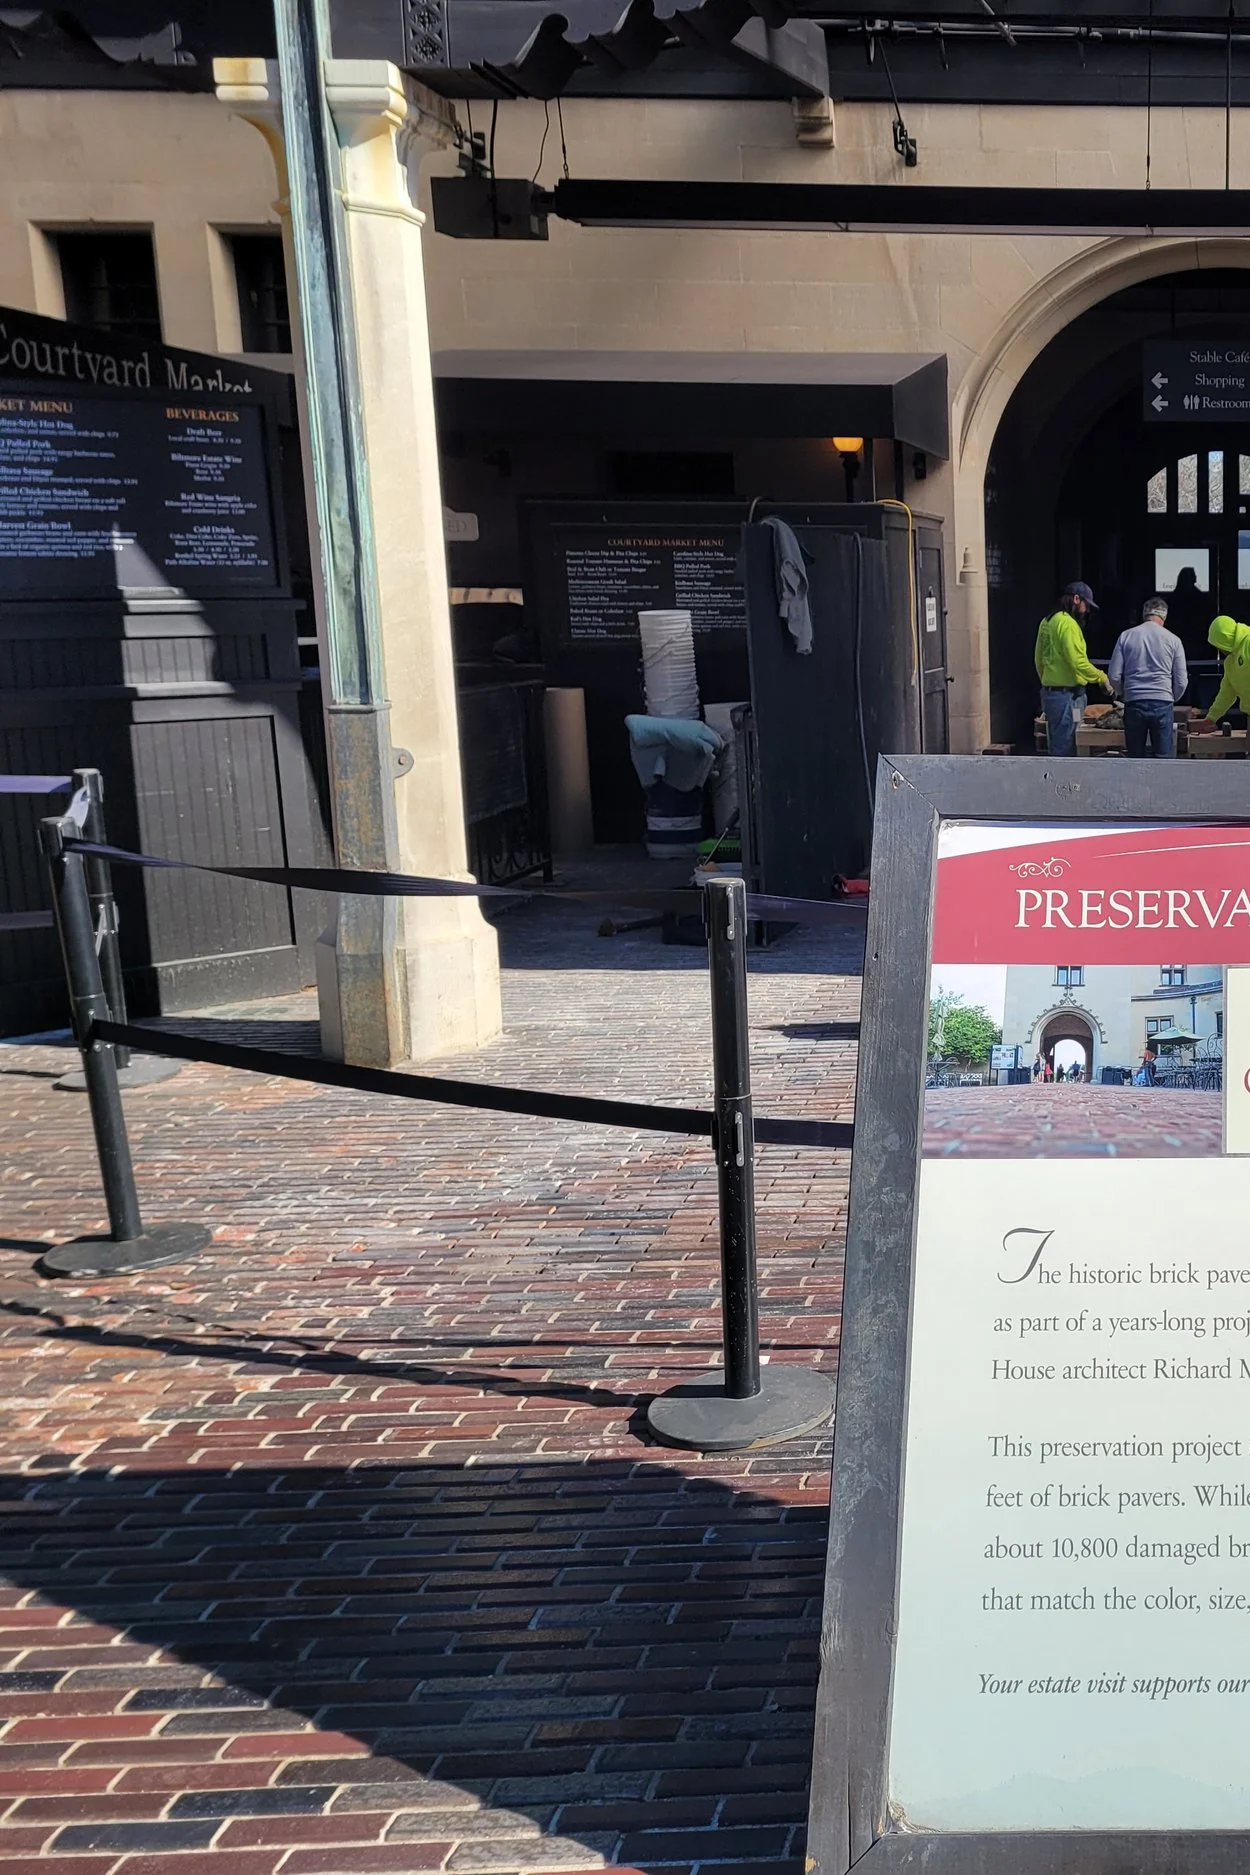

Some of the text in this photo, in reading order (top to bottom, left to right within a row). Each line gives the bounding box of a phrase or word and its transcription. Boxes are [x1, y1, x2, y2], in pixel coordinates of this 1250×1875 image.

[1189, 351, 1250, 364] Stable Café
[1195, 373, 1246, 389] Shopping
[30, 400, 73, 414] MENU
[165, 407, 239, 422] BEVERAGES
[607, 538, 724, 547] COURTYARD MARKET MENU
[997, 1228, 1061, 1284] The
[1069, 1263, 1142, 1284] historic
[1150, 1262, 1200, 1283] brick
[994, 1318, 1012, 1331] as
[1019, 1316, 1059, 1338] part
[1066, 1309, 1088, 1331] of
[1092, 1318, 1102, 1331] a
[1109, 1309, 1206, 1338] years-long
[992, 1360, 1055, 1379] House
[1063, 1358, 1147, 1379] architect
[1153, 1357, 1232, 1379] Richard
[988, 1435, 1031, 1457] This
[1040, 1435, 1163, 1464] preservation
[1171, 1434, 1242, 1463] project
[986, 1484, 1023, 1507] feet
[1030, 1484, 1054, 1507] of
[1059, 1484, 1110, 1507] brick
[1118, 1492, 1185, 1513] pavers.
[984, 1535, 1043, 1558] about
[1053, 1538, 1117, 1562] 10,800
[1126, 1535, 1220, 1565] damaged
[982, 1587, 1023, 1610] that
[1030, 1587, 1095, 1610] match
[1104, 1586, 1136, 1609] the
[1144, 1586, 1200, 1614] color,
[1209, 1587, 1250, 1614] size,
[979, 1674, 1023, 1694] Your
[1028, 1676, 1081, 1693] estate
[1088, 1672, 1127, 1693] visit
[1131, 1676, 1211, 1700] supports
[1217, 1679, 1250, 1693] our
